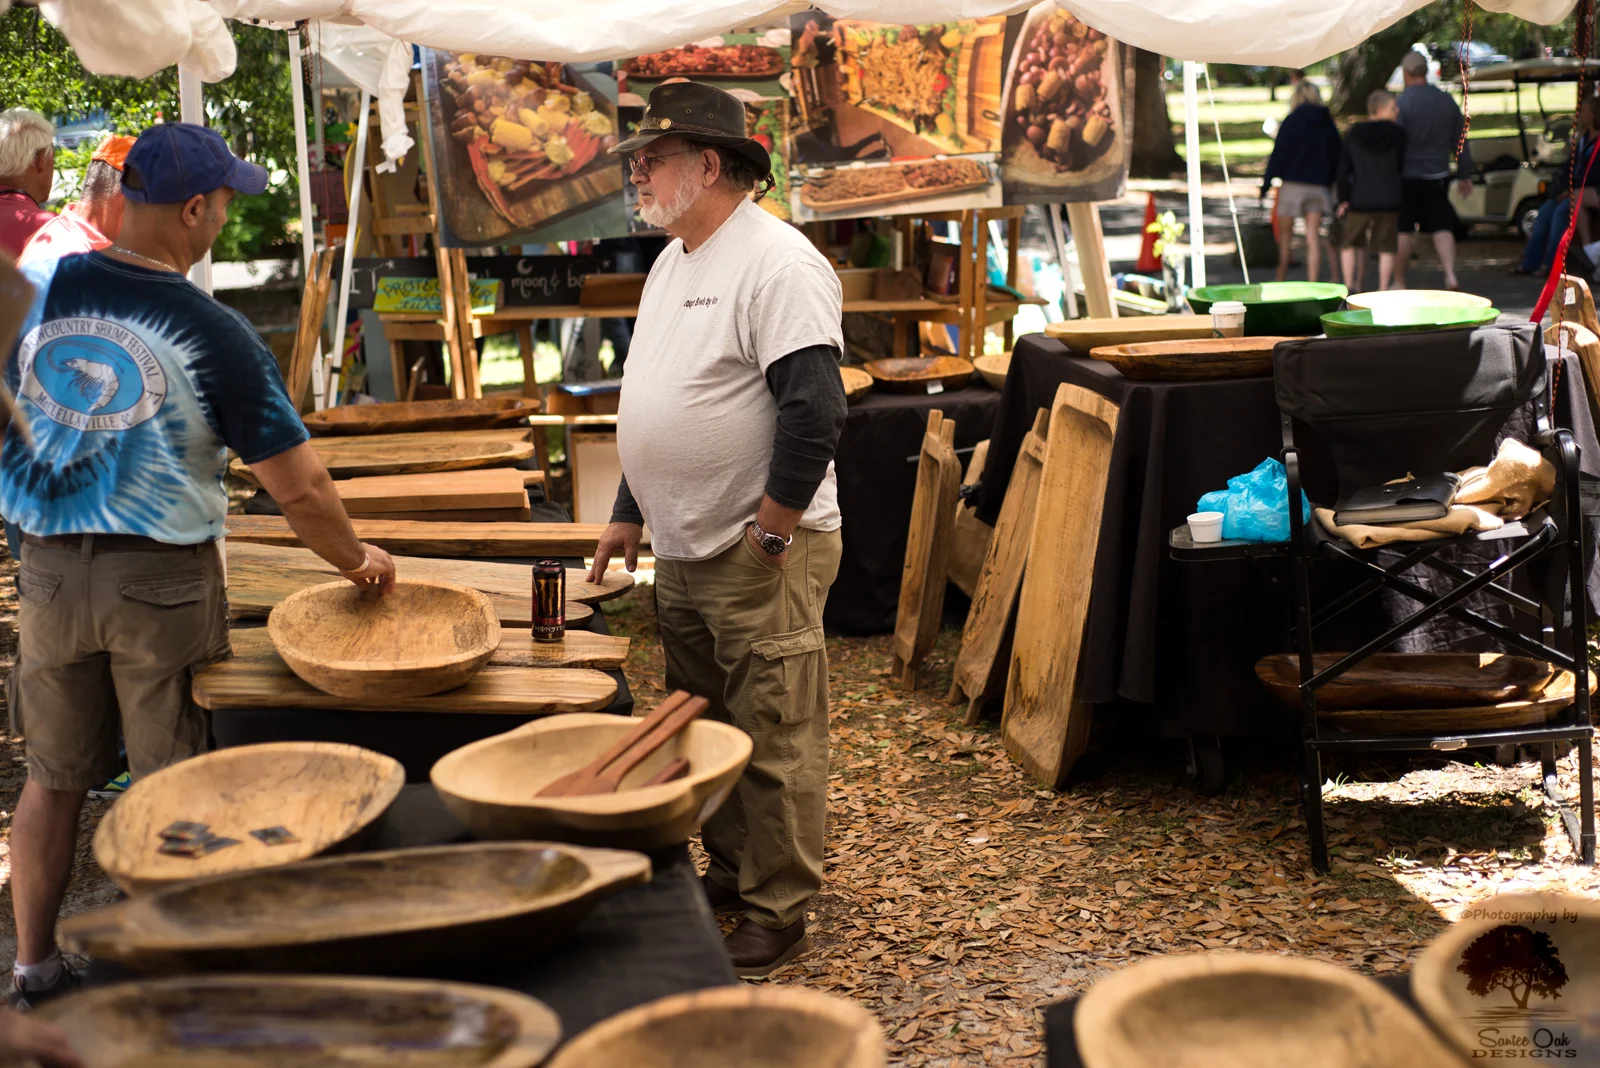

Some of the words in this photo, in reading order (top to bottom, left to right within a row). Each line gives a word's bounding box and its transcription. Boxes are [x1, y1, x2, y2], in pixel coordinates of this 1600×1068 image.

[511, 276, 552, 299] moon
[94, 321, 129, 345] SHRIMP
[125, 337, 160, 380] FESTIVAL
